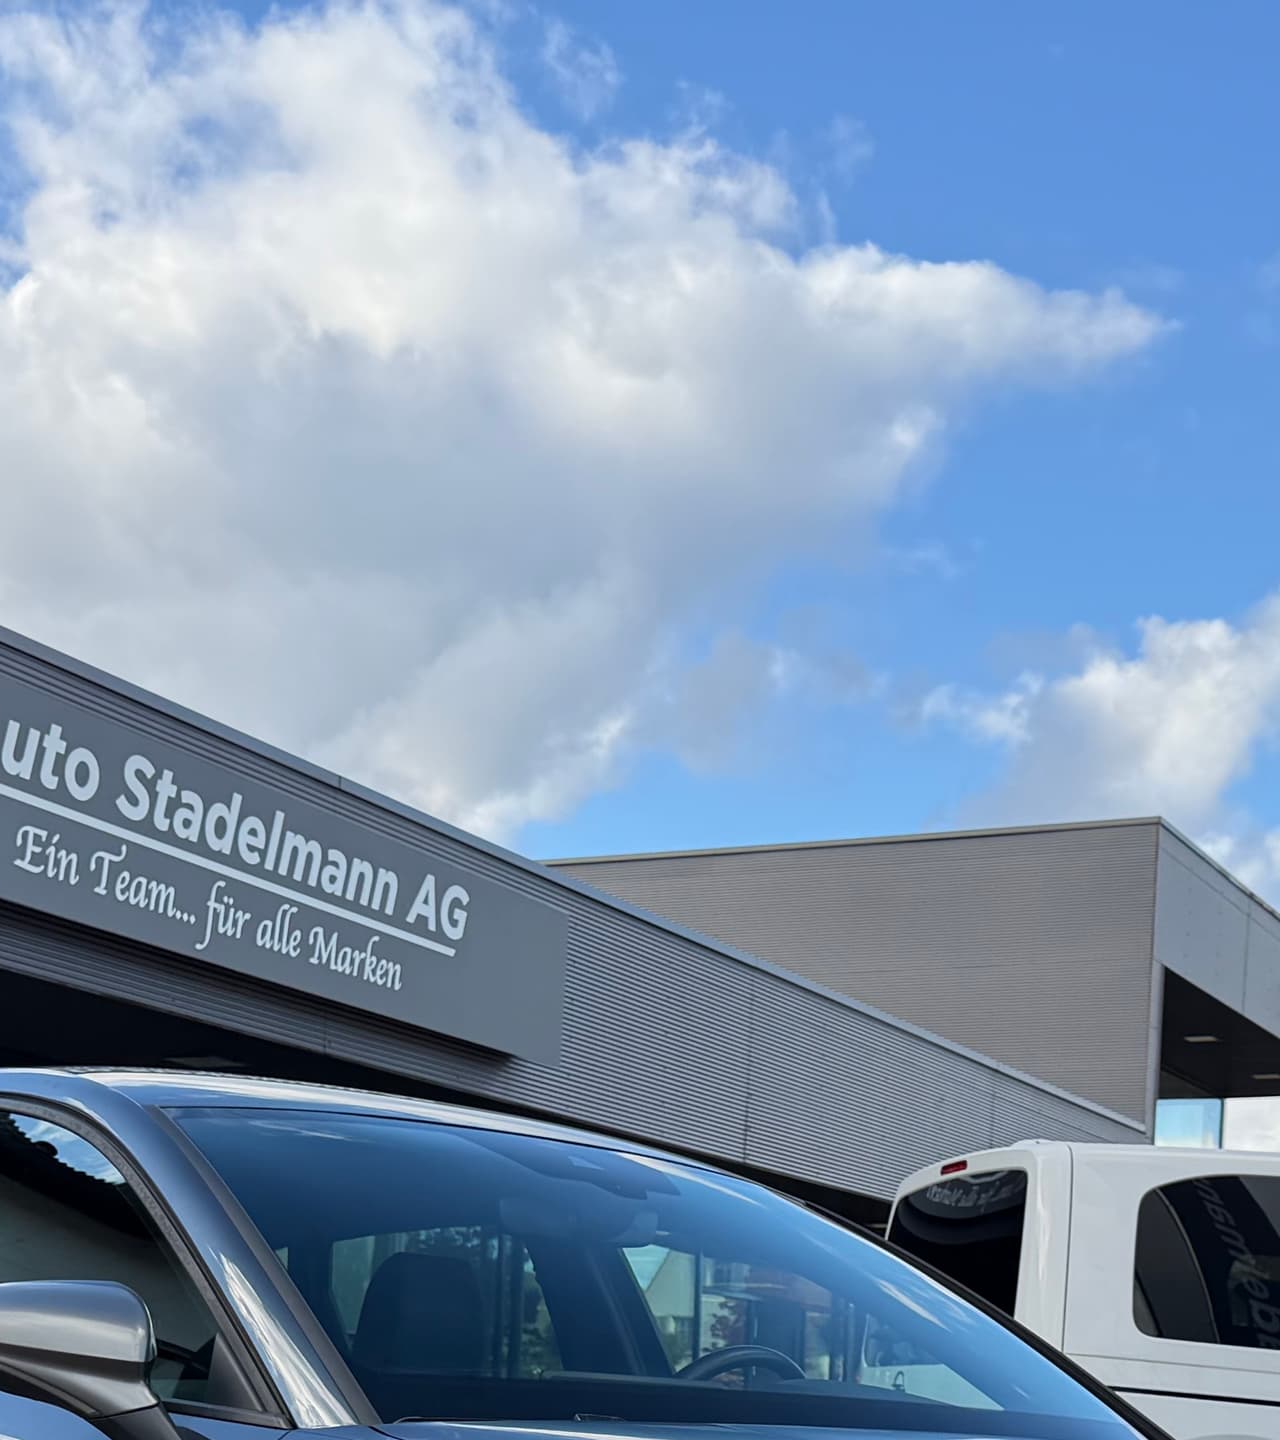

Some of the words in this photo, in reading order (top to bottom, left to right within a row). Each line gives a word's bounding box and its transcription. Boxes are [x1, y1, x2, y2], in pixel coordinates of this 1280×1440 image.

[14, 825, 80, 887] Ein
[90, 844, 197, 925] Team...
[196, 881, 251, 950] für
[256, 904, 302, 957] alle
[309, 926, 403, 990] Marken
[116, 754, 400, 915] Stadelmann
[406, 873, 471, 941] AG
